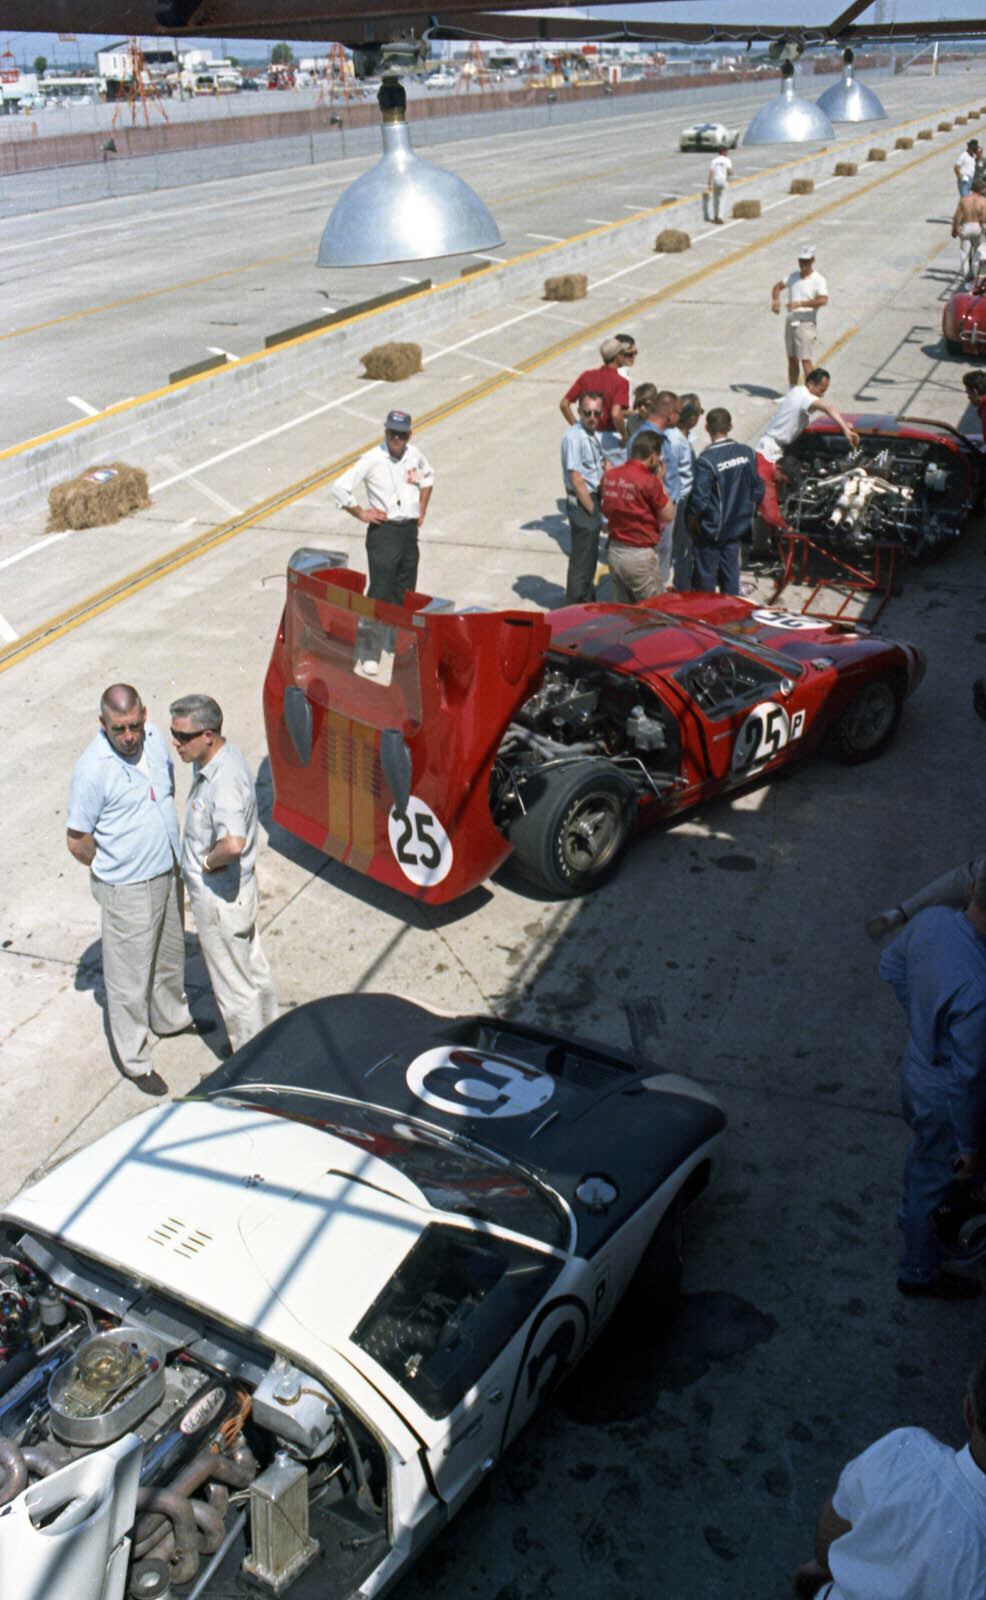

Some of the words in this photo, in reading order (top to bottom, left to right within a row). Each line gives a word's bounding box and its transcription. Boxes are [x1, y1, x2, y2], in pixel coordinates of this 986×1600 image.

[743, 707, 783, 770] 25
[792, 715, 803, 737] P
[392, 809, 441, 870] 25
[422, 1050, 544, 1116] 3
